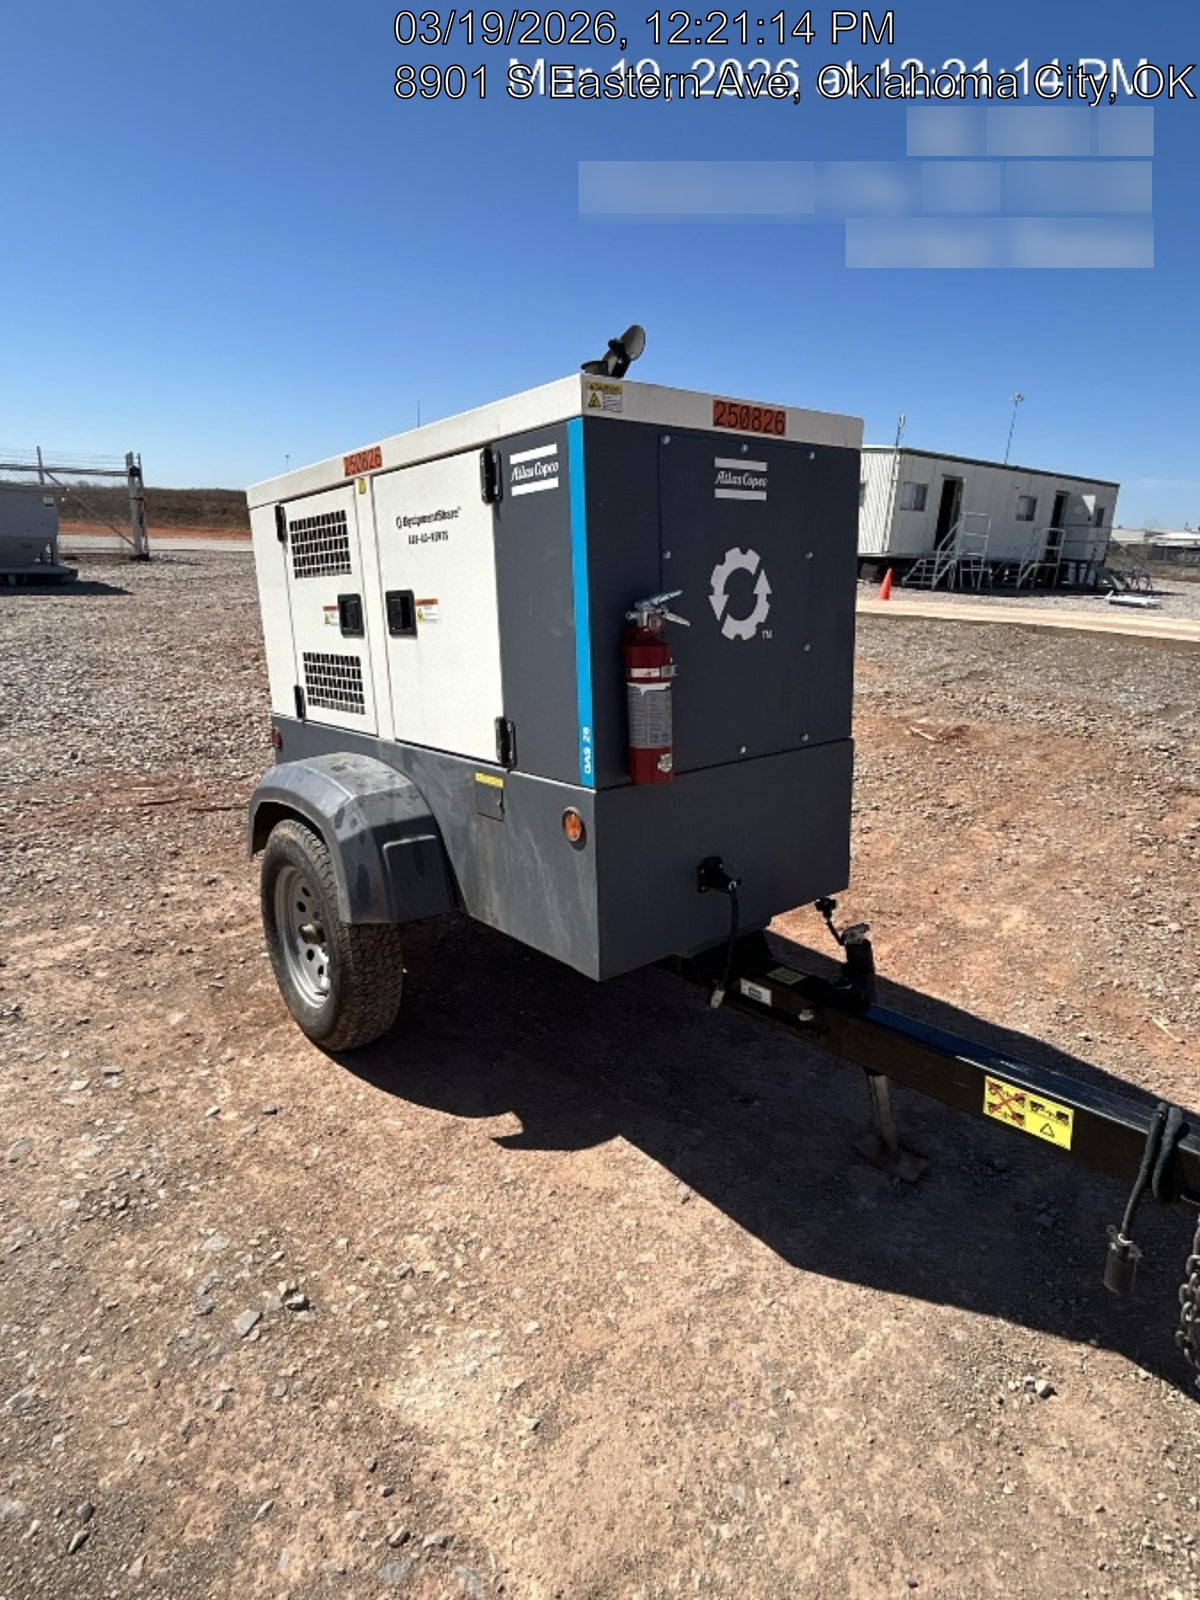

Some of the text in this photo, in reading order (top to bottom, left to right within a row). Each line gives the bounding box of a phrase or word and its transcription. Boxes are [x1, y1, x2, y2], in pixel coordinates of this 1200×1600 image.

[714, 401, 786, 435] 250826
[510, 461, 559, 482] Atlas Copco
[714, 471, 768, 489] Atlas Copco
